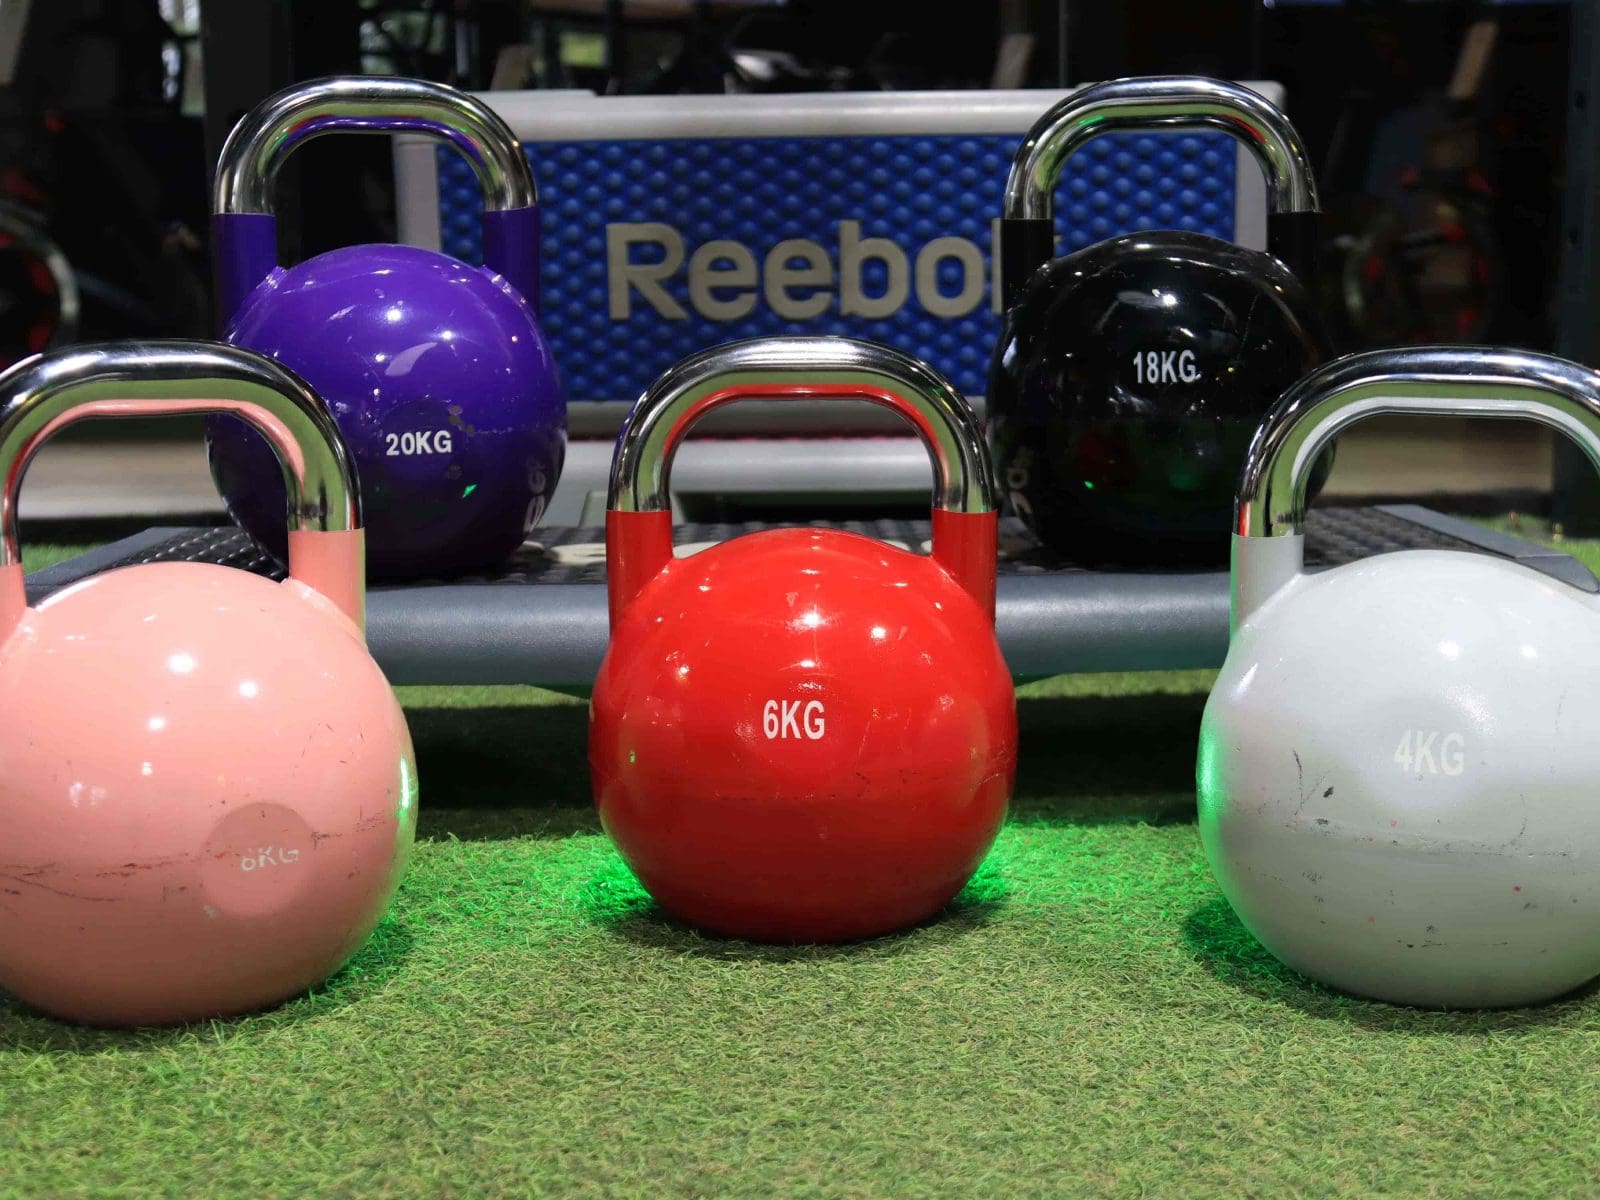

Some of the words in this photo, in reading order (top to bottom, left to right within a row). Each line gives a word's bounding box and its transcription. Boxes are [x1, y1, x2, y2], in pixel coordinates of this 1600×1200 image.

[606, 218, 1003, 320] Reebo
[1133, 350, 1197, 384] 18KG
[385, 430, 453, 456] 20KG
[763, 699, 825, 740] 6KG
[1393, 729, 1465, 777] 4KG
